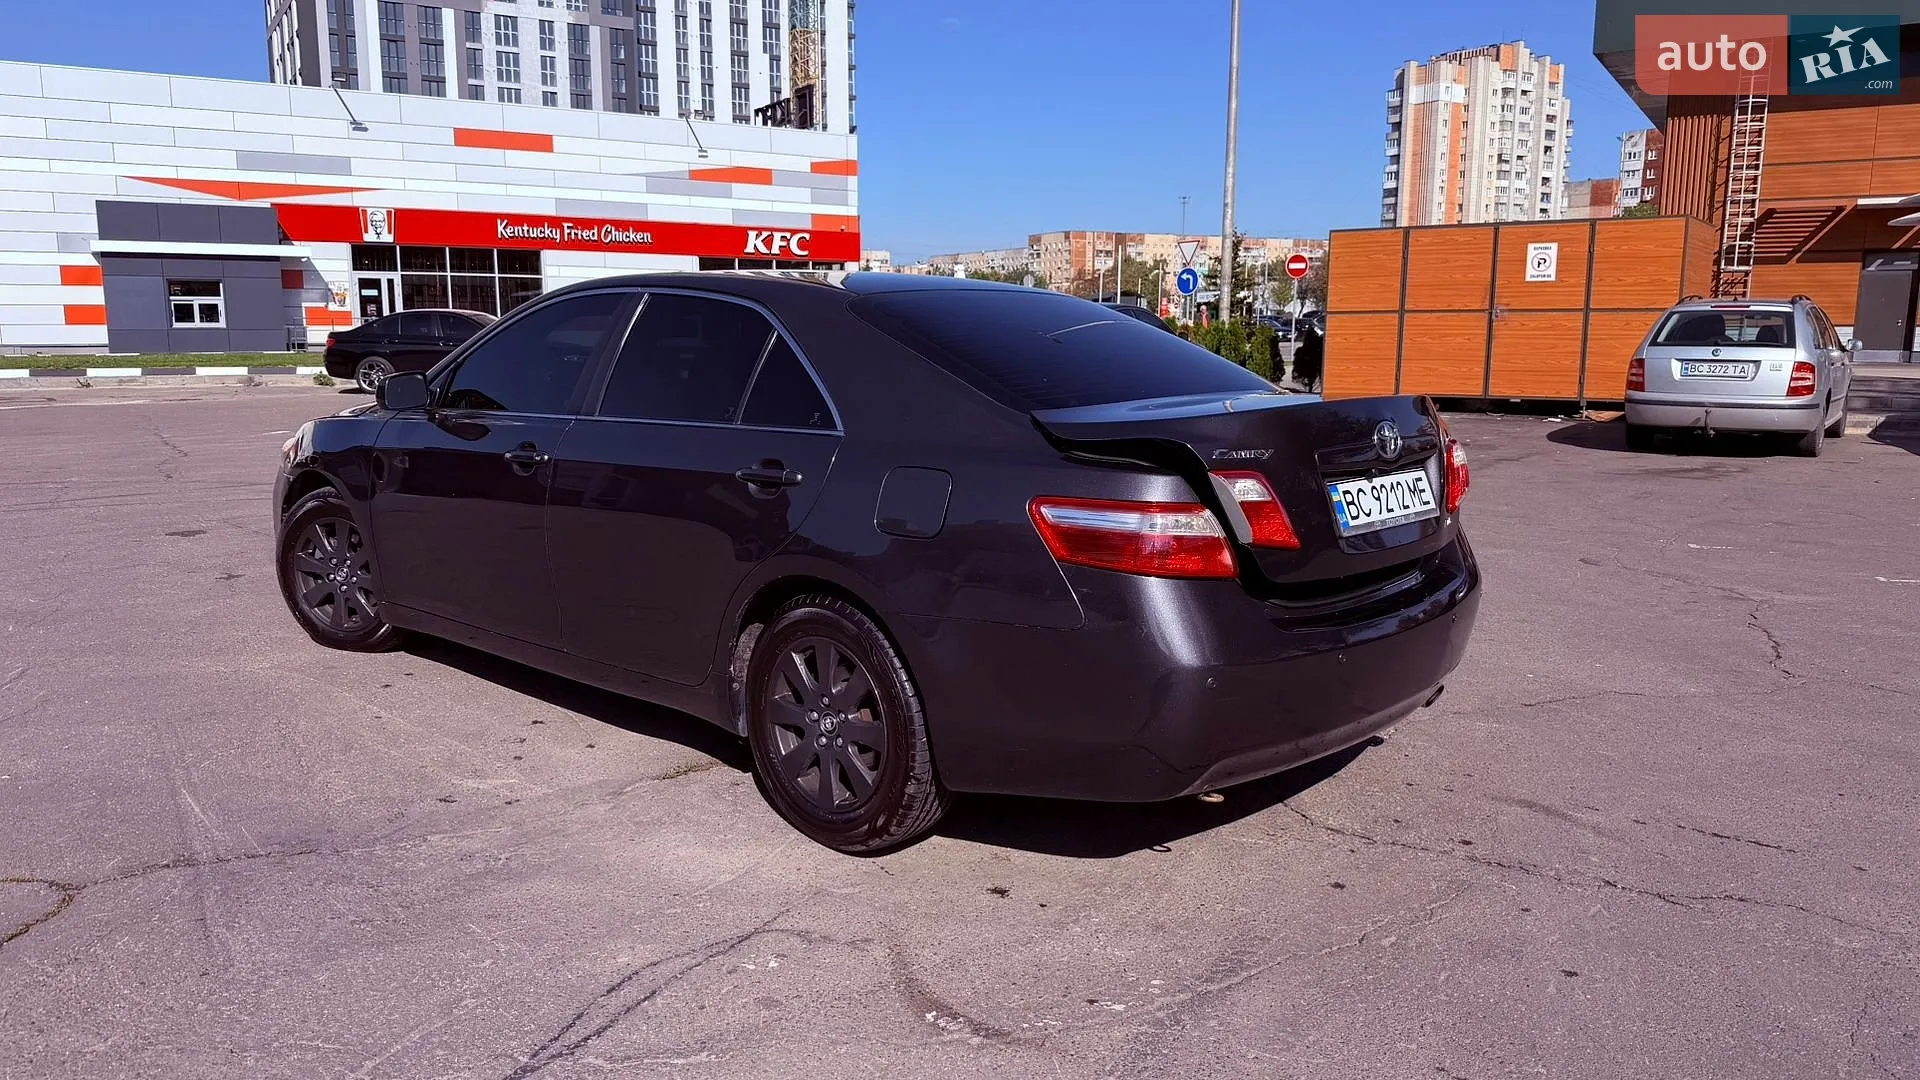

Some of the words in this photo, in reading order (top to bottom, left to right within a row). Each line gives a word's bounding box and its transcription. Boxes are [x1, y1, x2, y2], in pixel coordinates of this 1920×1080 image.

[496, 219, 560, 243] Kentucky
[562, 222, 598, 241] Fried
[601, 224, 653, 243] Chicken
[744, 230, 811, 256] KFC
[1689, 364, 1704, 373] BC
[1706, 364, 1729, 374] 3272
[1732, 365, 1746, 374] TA
[1211, 449, 1274, 460] CAMRY
[1342, 487, 1372, 521] BC
[1370, 481, 1410, 515] 9212
[1404, 476, 1431, 508] ME
